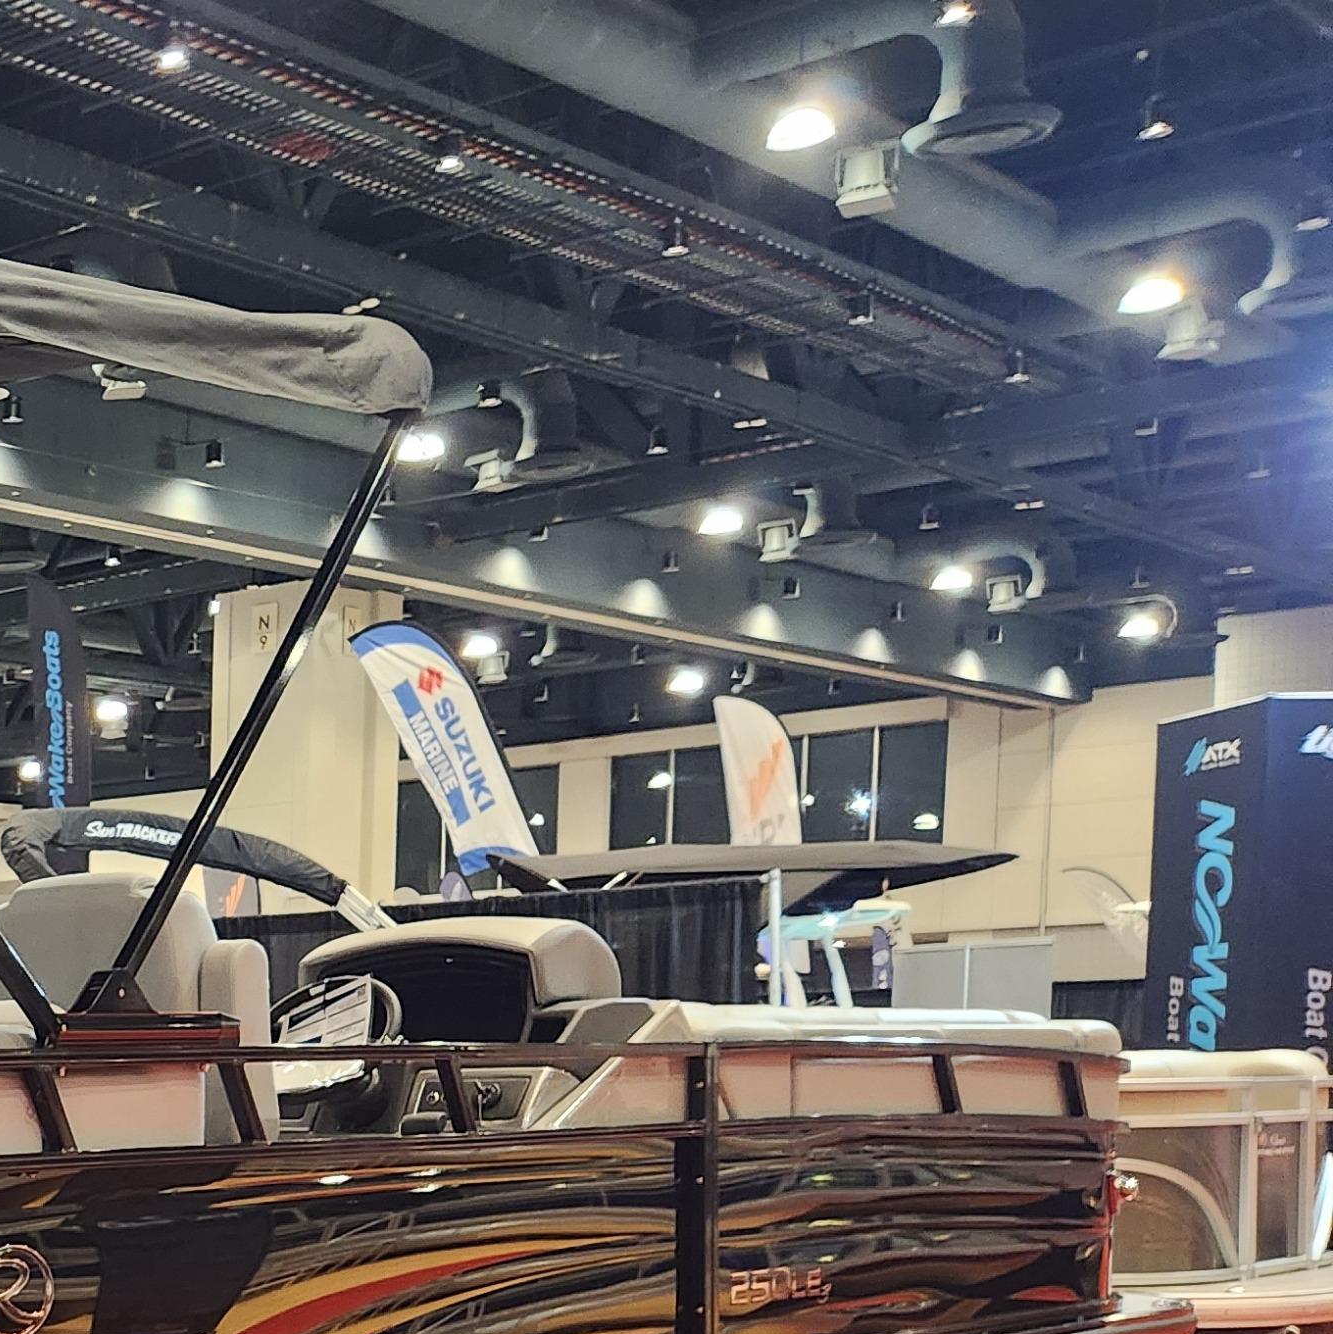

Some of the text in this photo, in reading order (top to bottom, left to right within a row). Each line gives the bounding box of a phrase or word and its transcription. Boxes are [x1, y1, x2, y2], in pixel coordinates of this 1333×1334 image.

[259, 615, 270, 629] N
[259, 635, 267, 650] 9
[65, 700, 74, 753] Company
[408, 712, 459, 796] MARINE
[434, 697, 495, 813] SUZUKI
[1201, 737, 1242, 764] ATX
[1166, 975, 1184, 1043] Boat
[1304, 967, 1332, 1040] Boat
